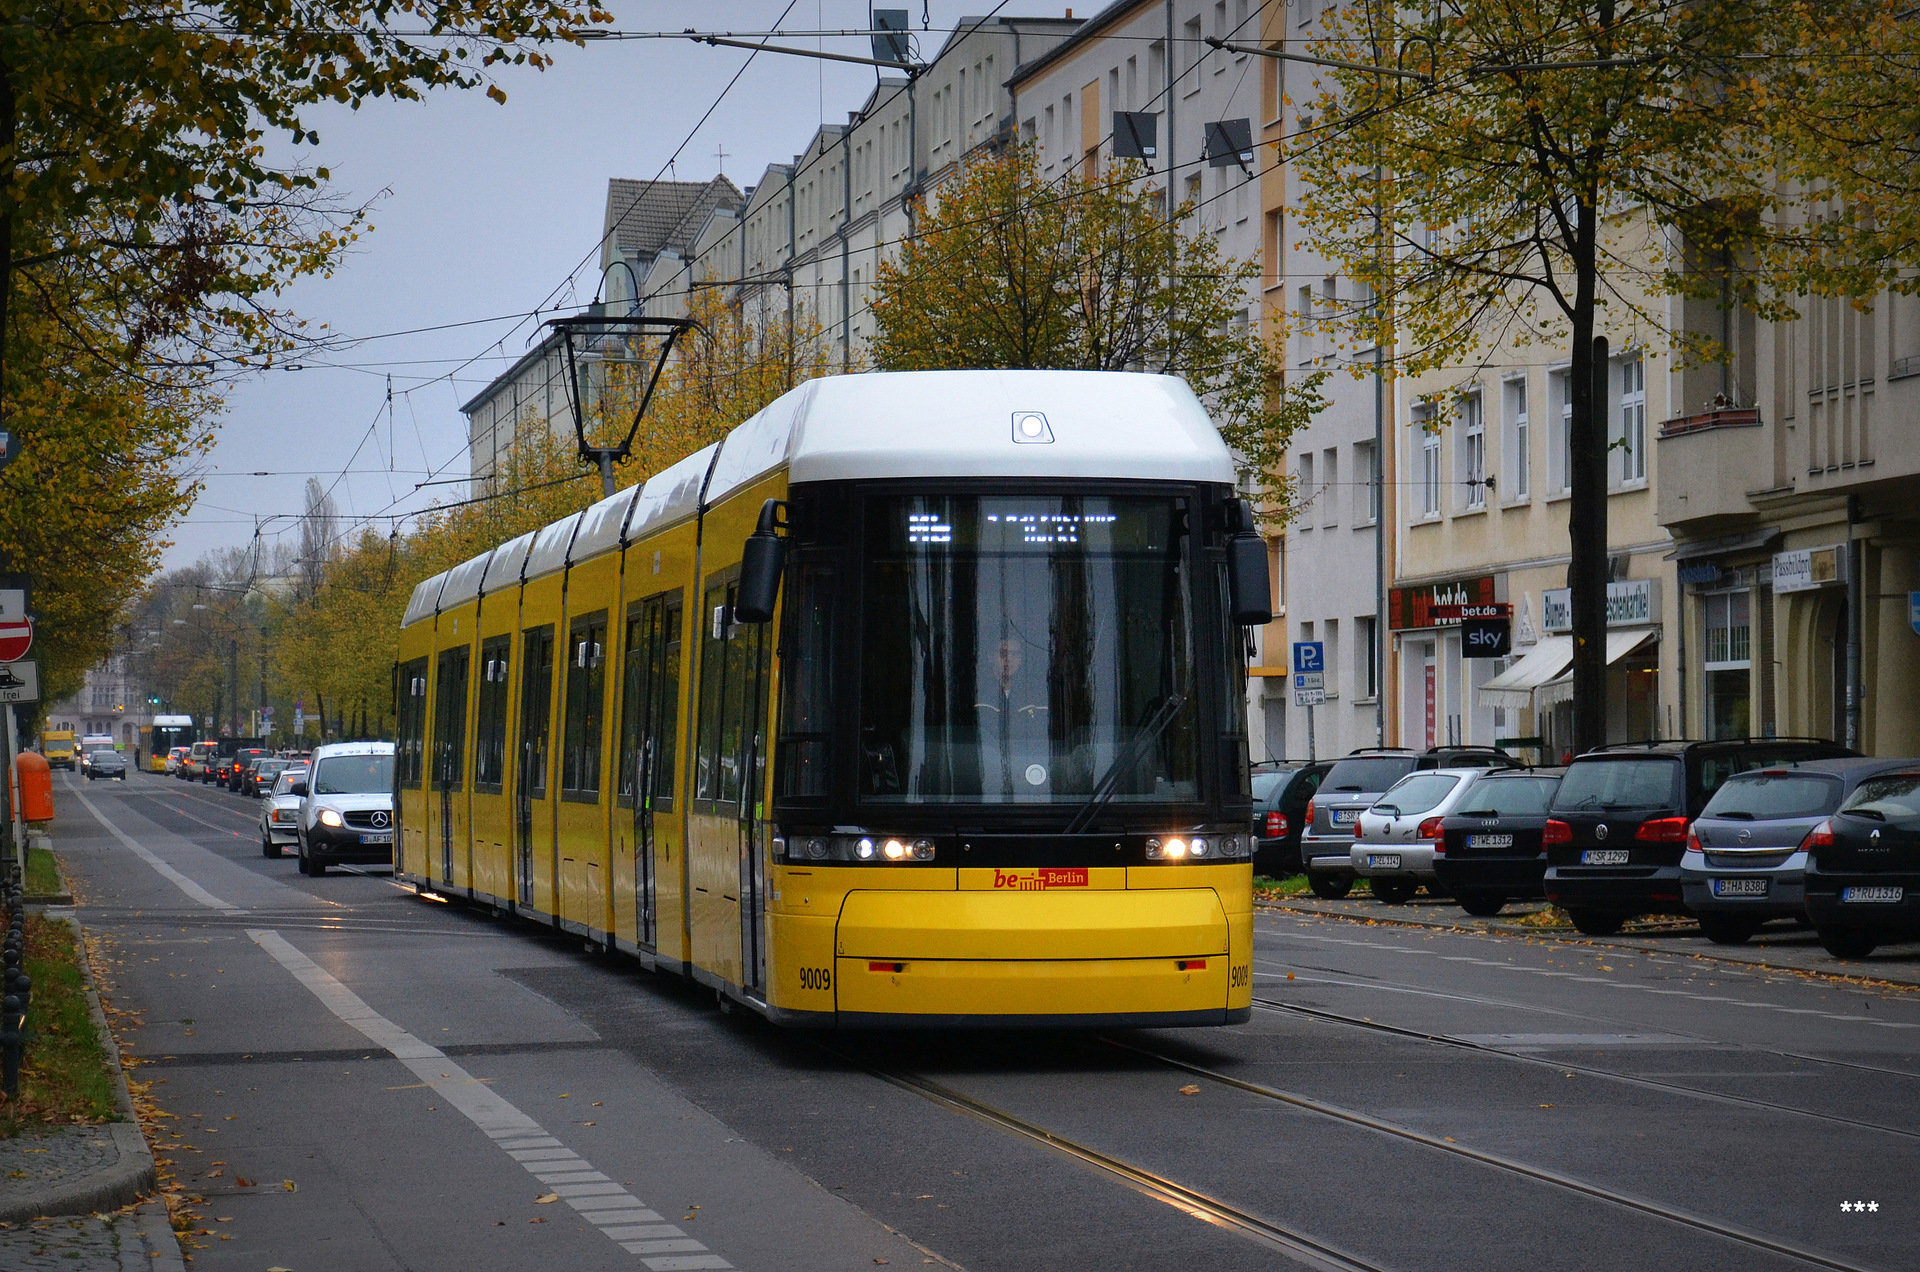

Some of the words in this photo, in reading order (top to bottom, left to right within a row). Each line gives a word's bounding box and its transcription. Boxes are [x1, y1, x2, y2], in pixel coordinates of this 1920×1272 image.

[1468, 627, 1503, 649] sky
[3, 689, 20, 700] frei
[993, 869, 1018, 888] be
[1048, 872, 1084, 884] Berlin
[800, 967, 831, 990] 9009
[1231, 965, 1248, 988] 9009
